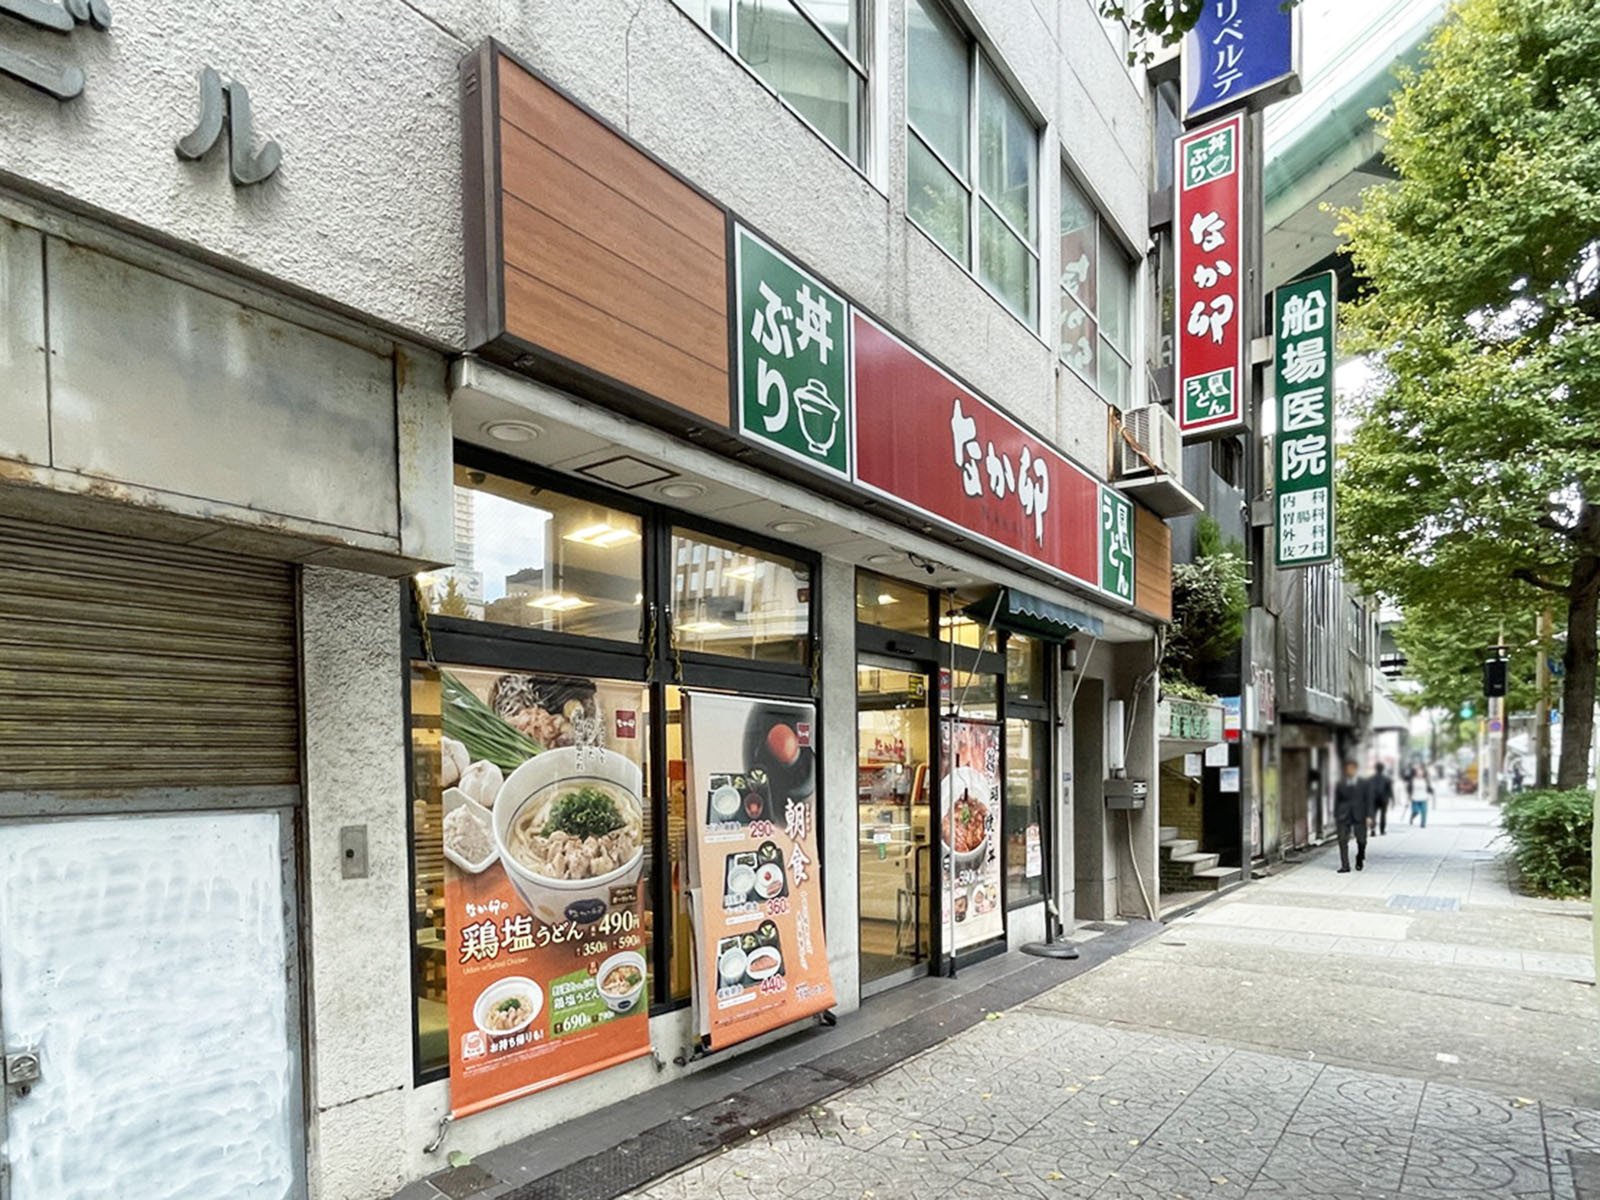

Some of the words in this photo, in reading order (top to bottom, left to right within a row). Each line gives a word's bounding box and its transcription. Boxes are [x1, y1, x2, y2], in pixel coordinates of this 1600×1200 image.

[1187, 211, 1235, 345] なか卯
[751, 283, 834, 433] 丼ぶり
[1187, 379, 1226, 416] うどん
[1281, 289, 1327, 482] 船場医院
[950, 397, 1050, 550] なか卯
[1103, 493, 1129, 596] うどん
[783, 797, 811, 887] 朝食
[460, 914, 585, 964] 鶏塩うどん
